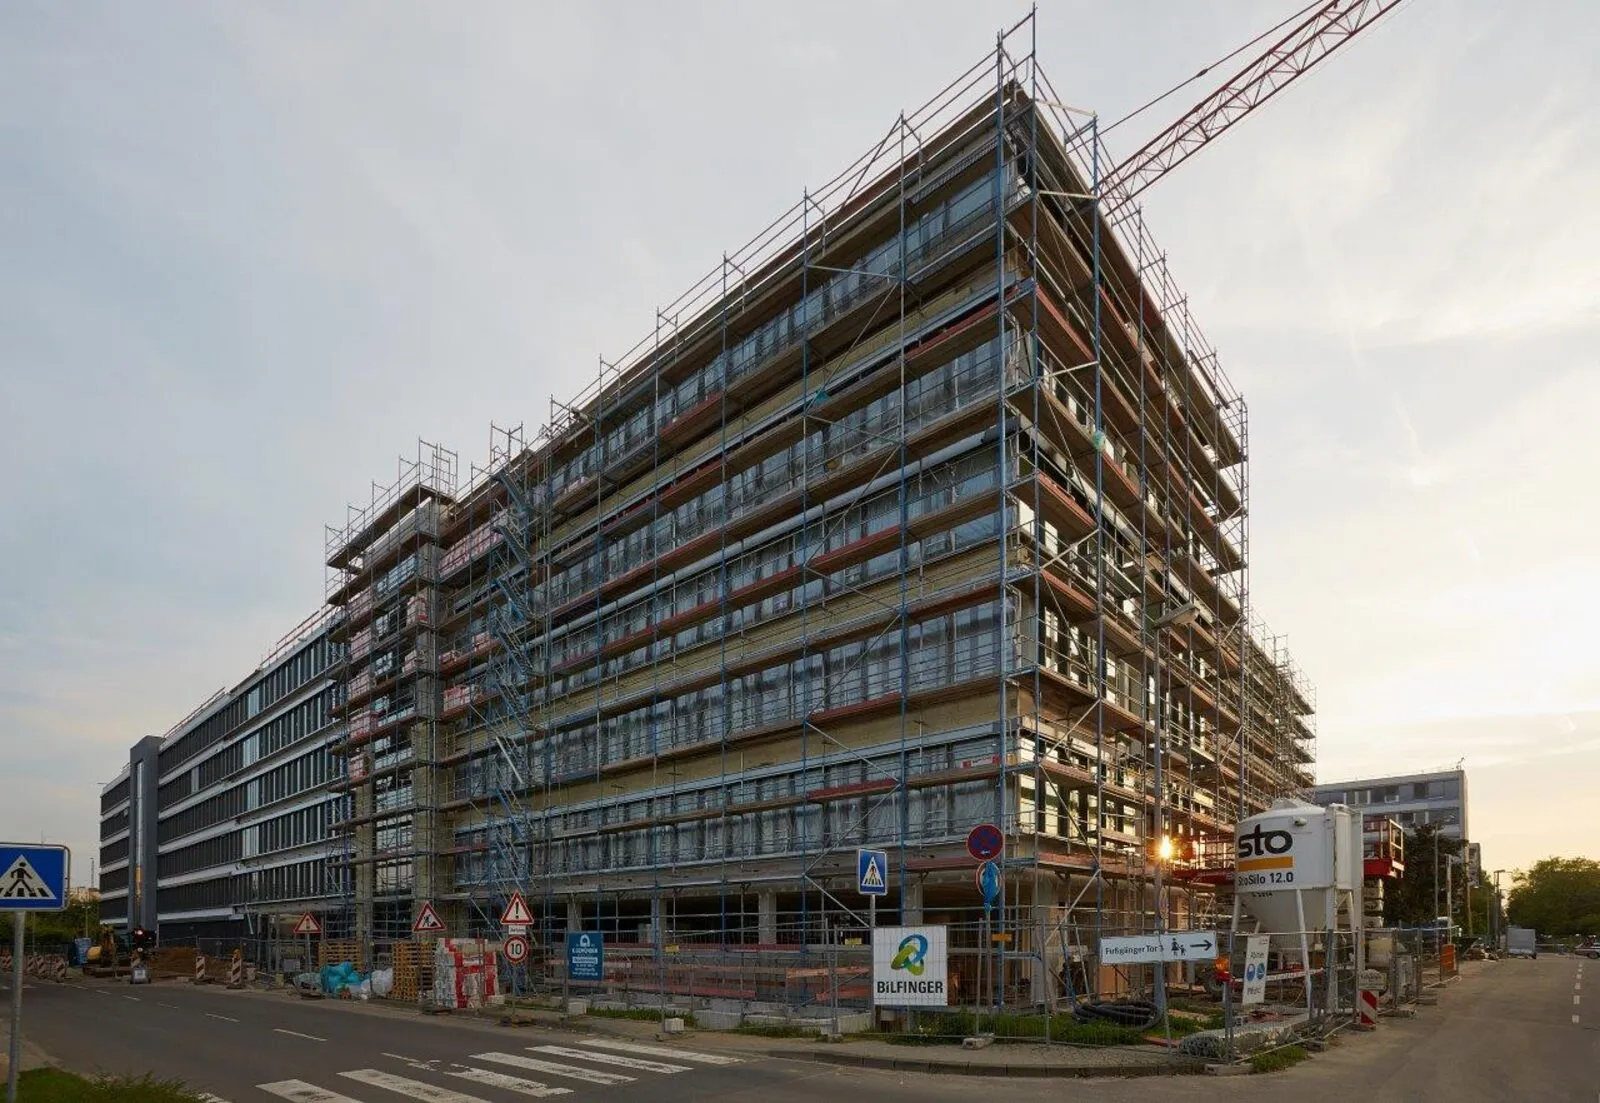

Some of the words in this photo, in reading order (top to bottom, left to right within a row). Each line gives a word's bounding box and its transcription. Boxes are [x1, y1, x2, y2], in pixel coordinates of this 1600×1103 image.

[1238, 823, 1293, 858] sto
[1269, 871, 1294, 884] 12.0
[511, 943, 522, 955] 10
[1105, 945, 1145, 956] Fußgänger
[1146, 944, 1158, 953] Tor
